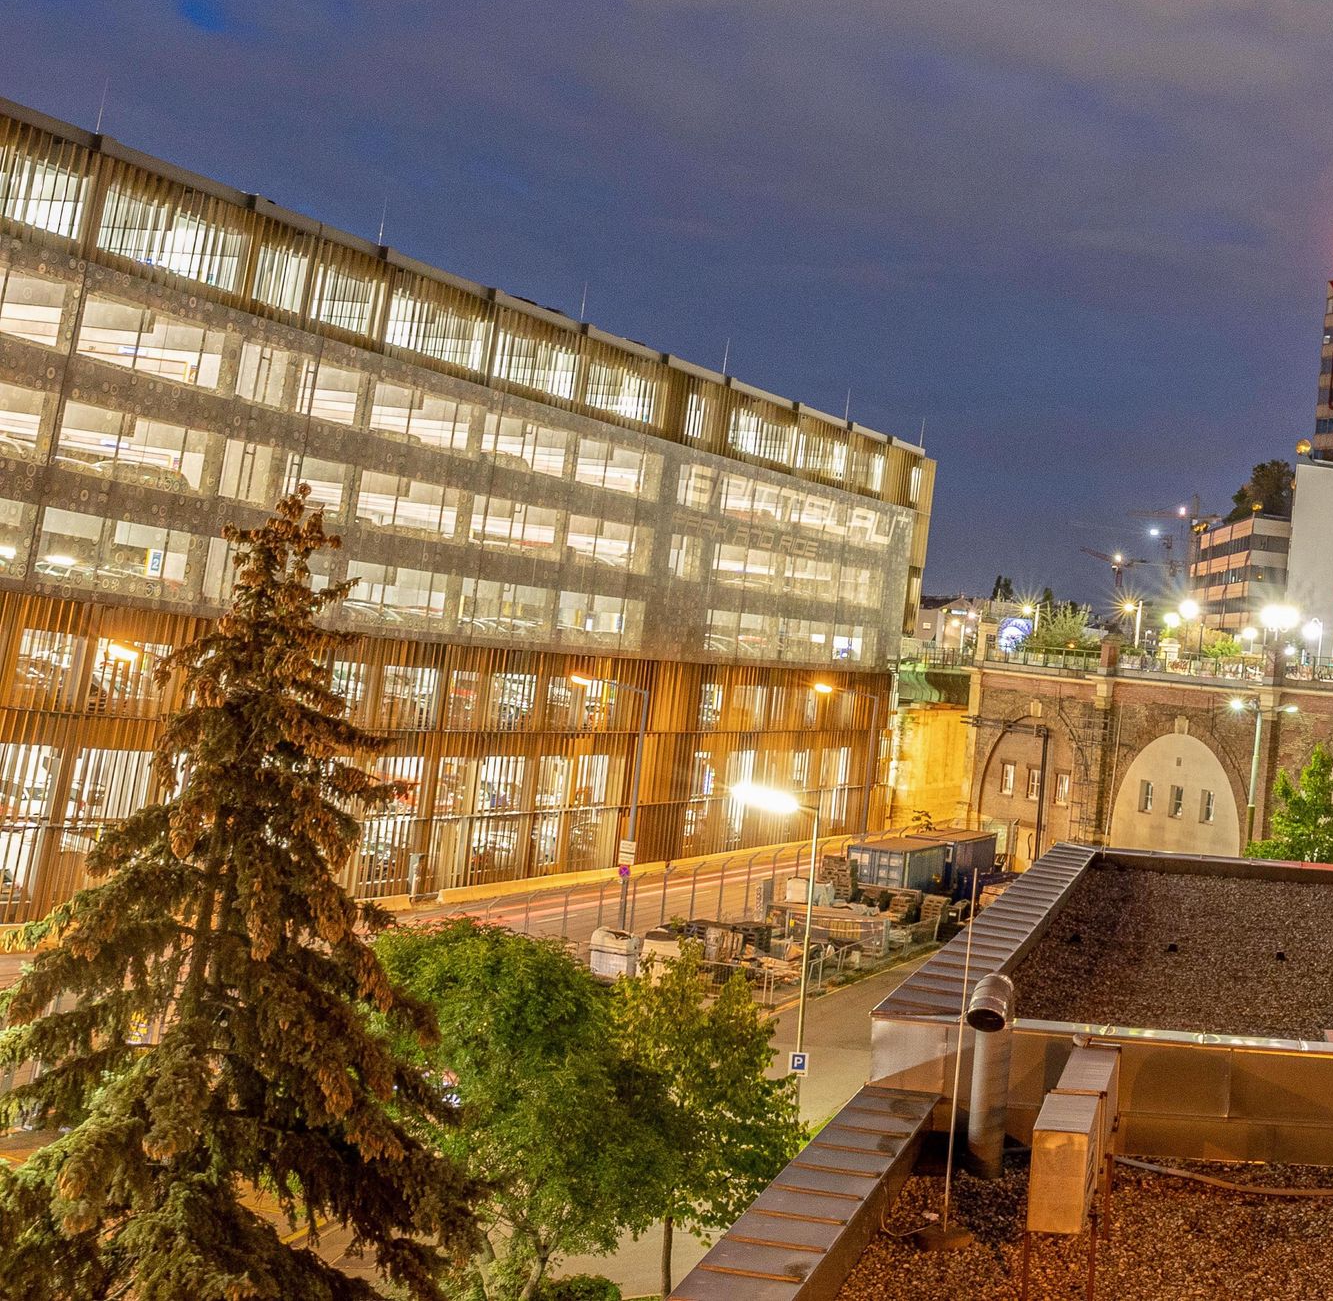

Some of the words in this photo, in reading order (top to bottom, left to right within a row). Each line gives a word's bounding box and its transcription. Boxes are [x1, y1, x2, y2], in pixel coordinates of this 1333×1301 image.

[672, 511, 731, 539] PARK
[780, 534, 819, 558] RIDE
[681, 463, 897, 545] SPITTELAU
